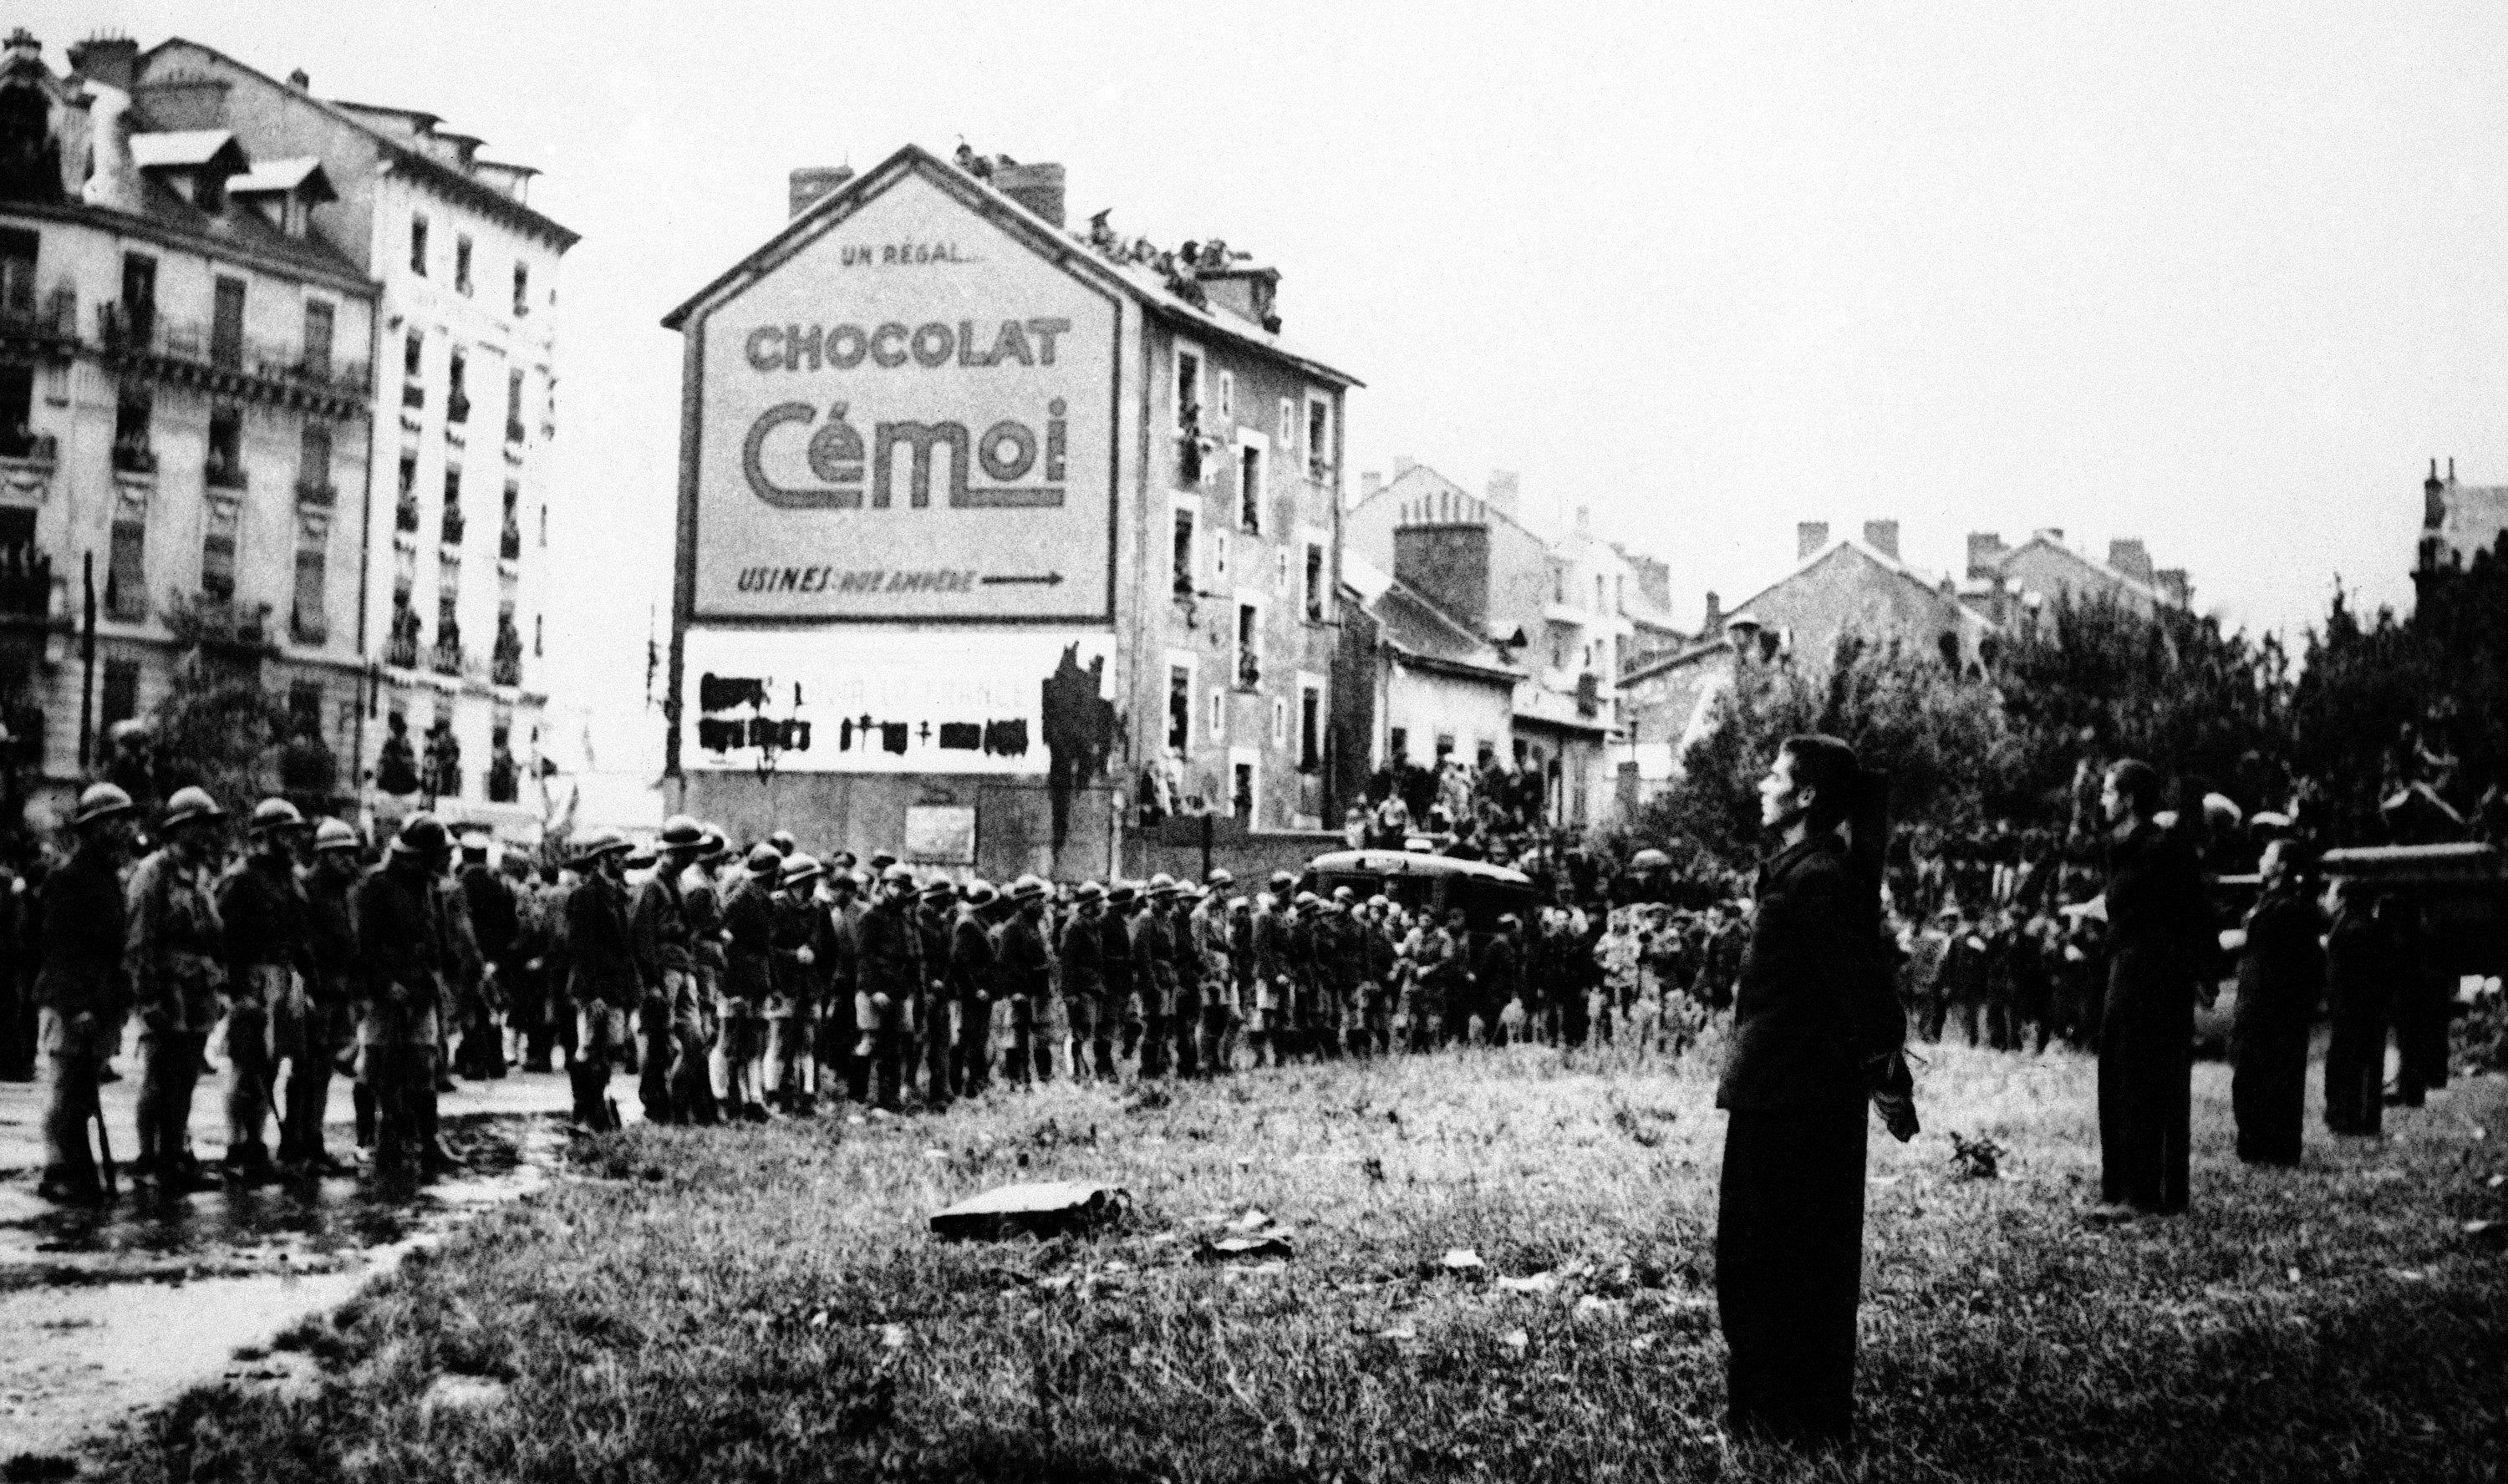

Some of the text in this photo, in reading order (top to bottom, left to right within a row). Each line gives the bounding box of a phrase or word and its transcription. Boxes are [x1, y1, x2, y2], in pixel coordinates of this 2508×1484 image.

[841, 243, 872, 267] UN
[745, 317, 1071, 371] CHOCOLAT
[742, 396, 1067, 509] Cémoi
